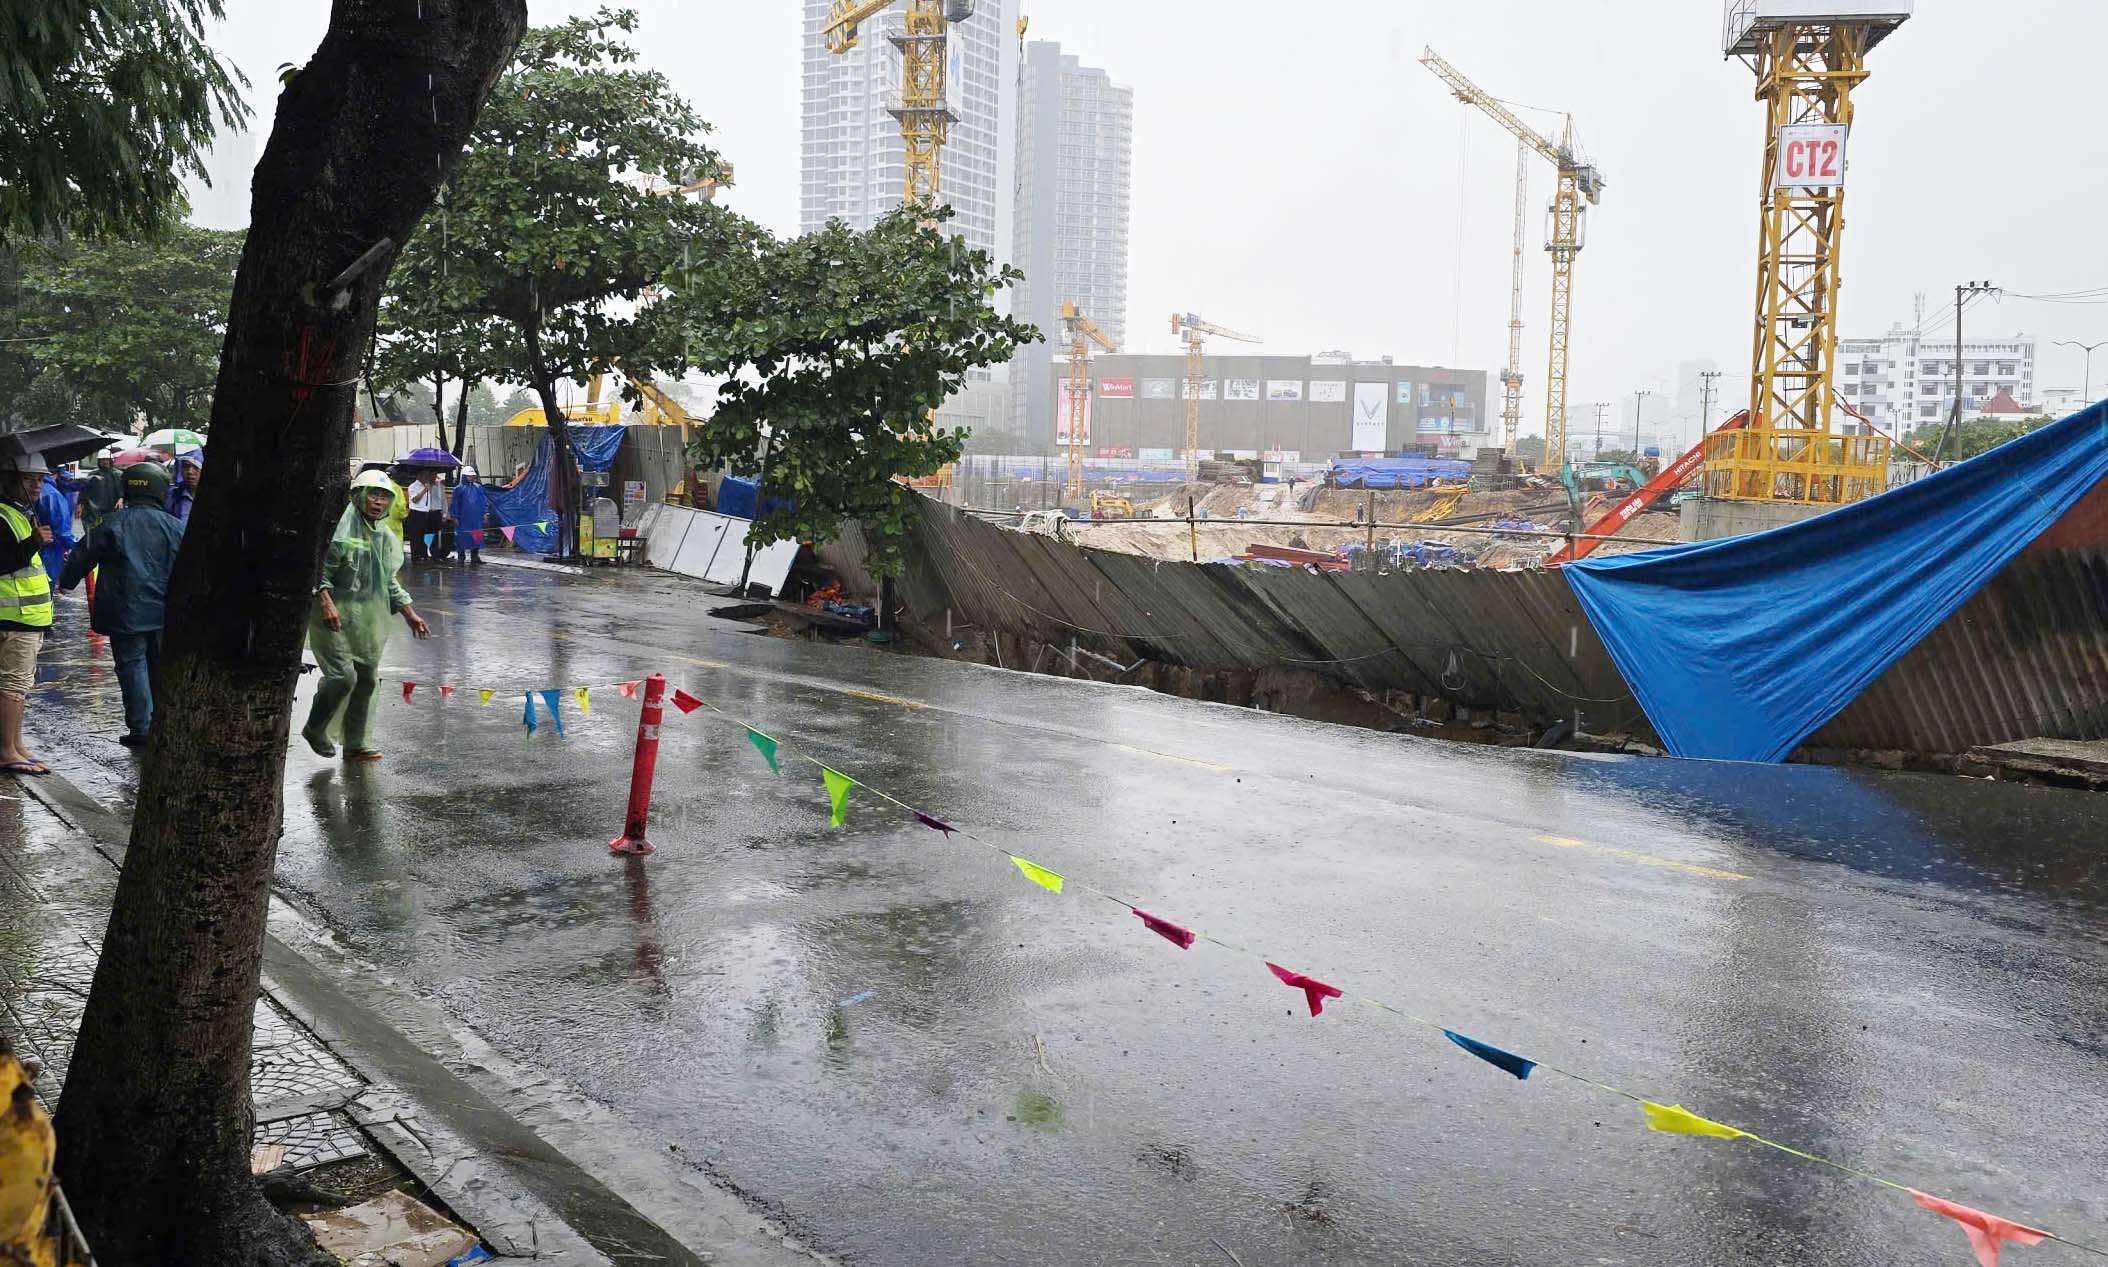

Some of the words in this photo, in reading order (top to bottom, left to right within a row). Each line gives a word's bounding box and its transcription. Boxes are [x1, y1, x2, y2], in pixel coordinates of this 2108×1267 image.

[1786, 140, 1838, 178] CT2
[1102, 383, 1133, 392] WinMart
[1673, 451, 1702, 475] HITACHI
